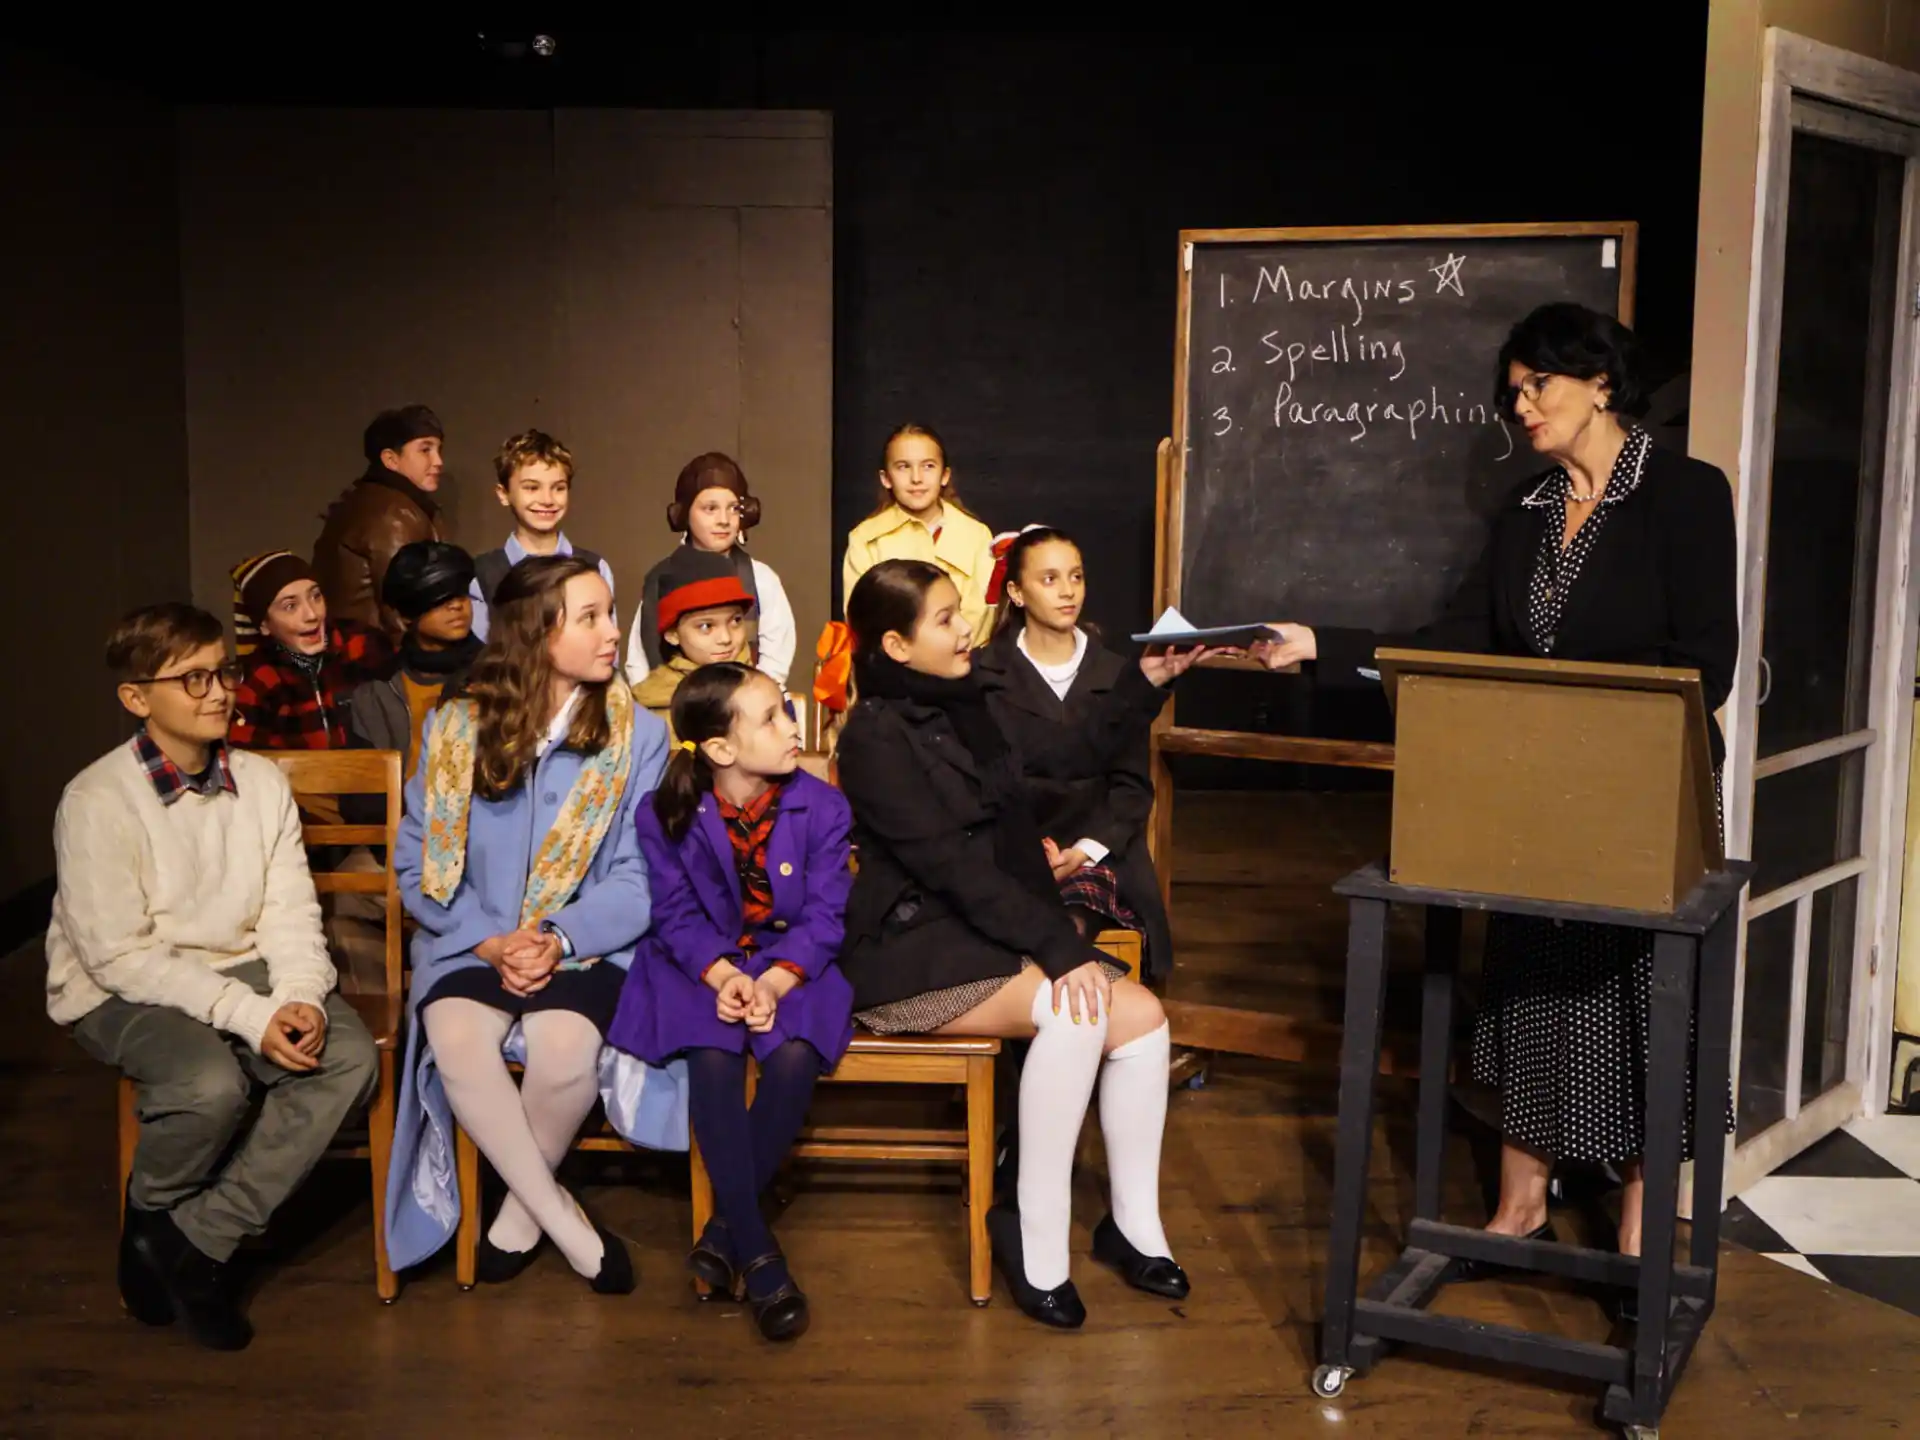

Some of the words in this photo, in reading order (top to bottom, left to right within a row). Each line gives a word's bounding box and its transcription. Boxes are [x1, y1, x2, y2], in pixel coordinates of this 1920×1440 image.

[1219, 273, 1235, 308] 1.
[1211, 346, 1237, 373] 2.
[1261, 325, 1406, 381] Spelling
